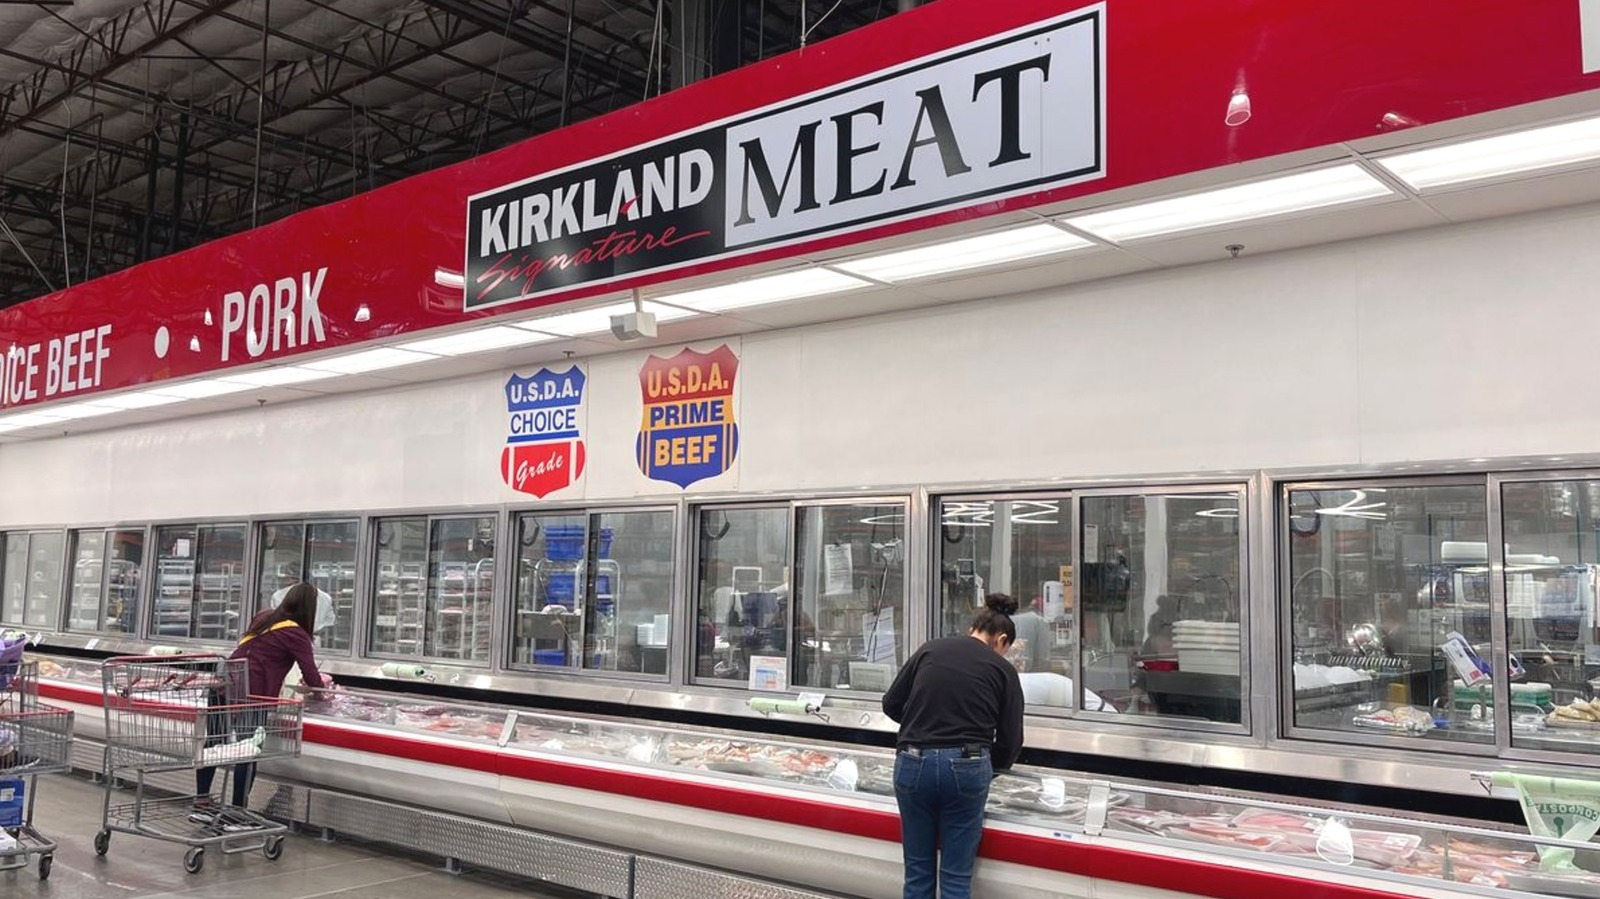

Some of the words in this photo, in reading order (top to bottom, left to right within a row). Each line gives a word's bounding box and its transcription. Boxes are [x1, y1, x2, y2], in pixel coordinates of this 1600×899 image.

[480, 148, 714, 258] KIRKLAND
[733, 52, 1052, 228] MEAT
[476, 226, 711, 299] Signature
[45, 323, 112, 396] BEEF
[221, 266, 328, 362] PORK
[510, 378, 580, 404] U.S.D.A.
[646, 362, 729, 398] U.S.D.A.
[510, 408, 576, 434] CHOICE
[650, 400, 724, 428] PRIME
[654, 434, 717, 467] BEEF
[516, 451, 563, 490] Grade
